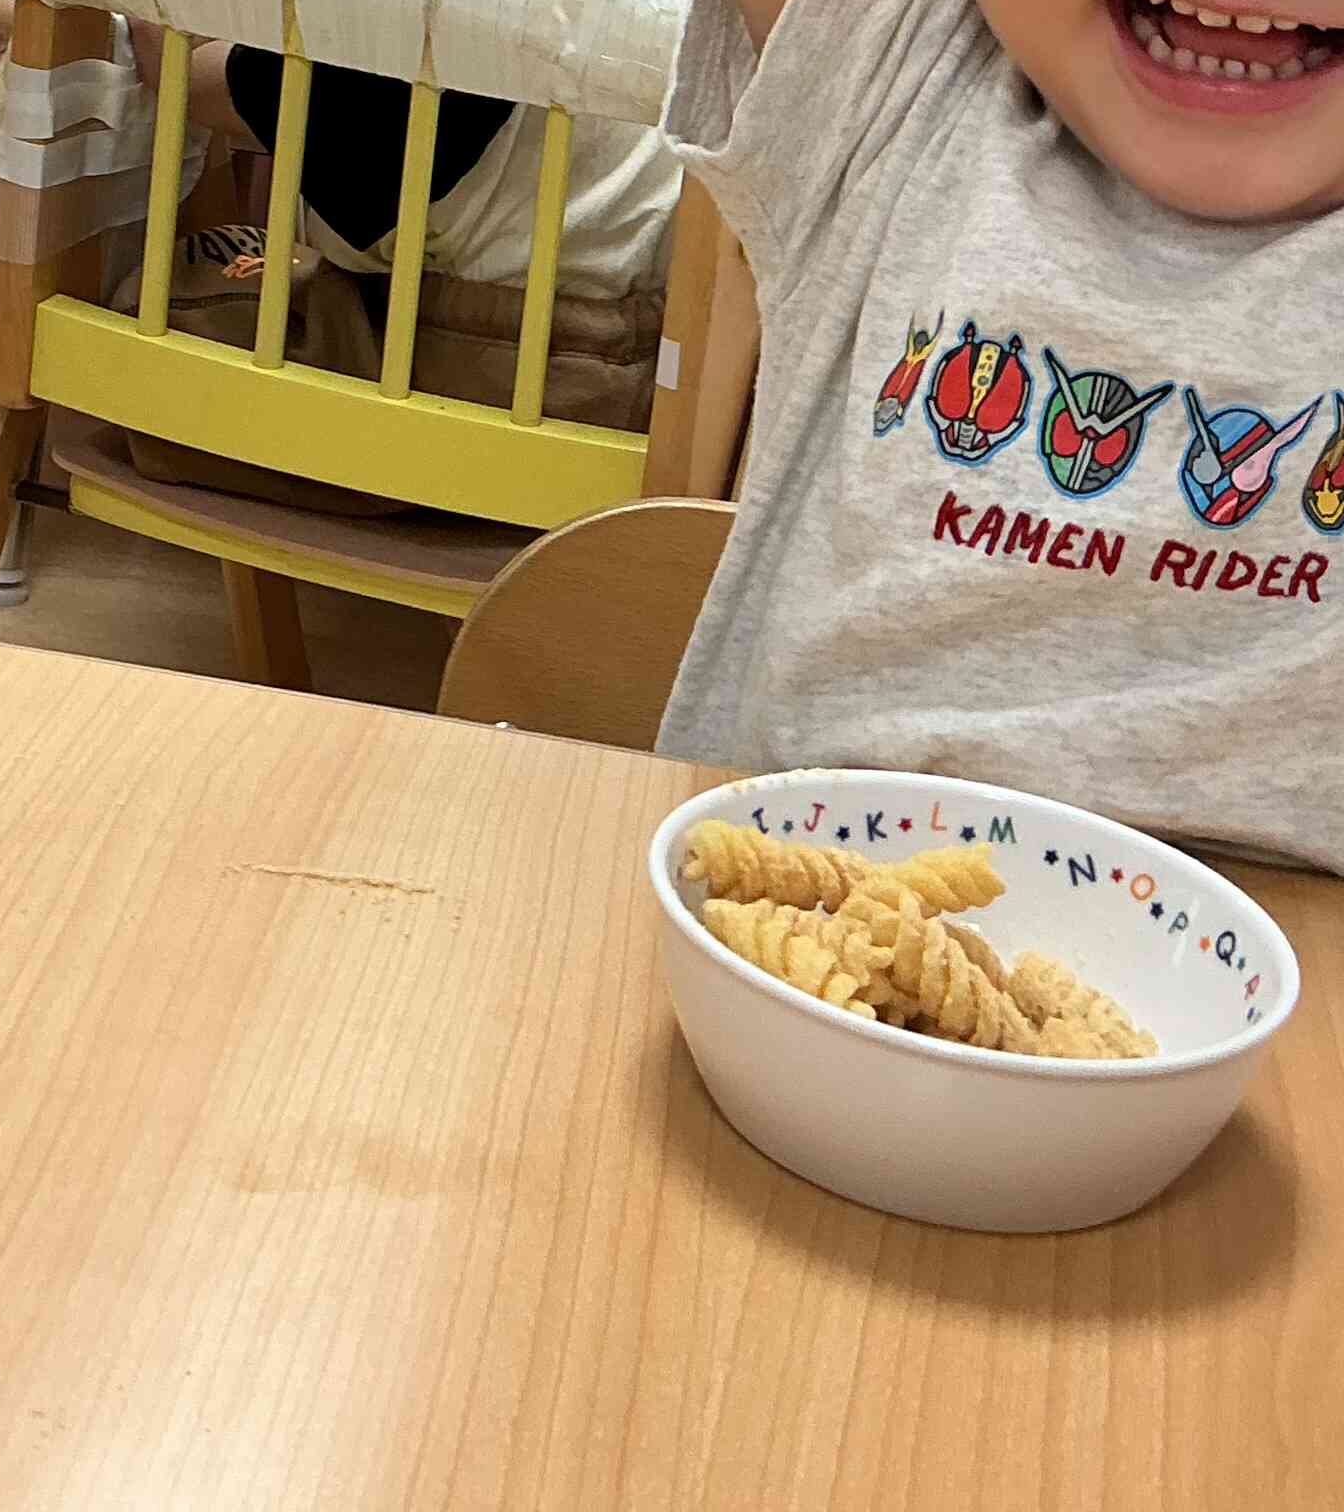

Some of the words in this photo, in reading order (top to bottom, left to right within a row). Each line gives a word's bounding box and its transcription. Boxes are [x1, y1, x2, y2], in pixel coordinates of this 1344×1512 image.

[933, 490, 1126, 577] KAMEN
[1150, 538, 1330, 604] RIDER
[805, 802, 825, 833] J
[866, 810, 888, 842] K
[930, 801, 948, 832] L
[988, 815, 1018, 844] M
[1067, 854, 1097, 887] N
[1129, 872, 1156, 901] O
[1167, 911, 1190, 935] P
[1215, 930, 1237, 968] Q
